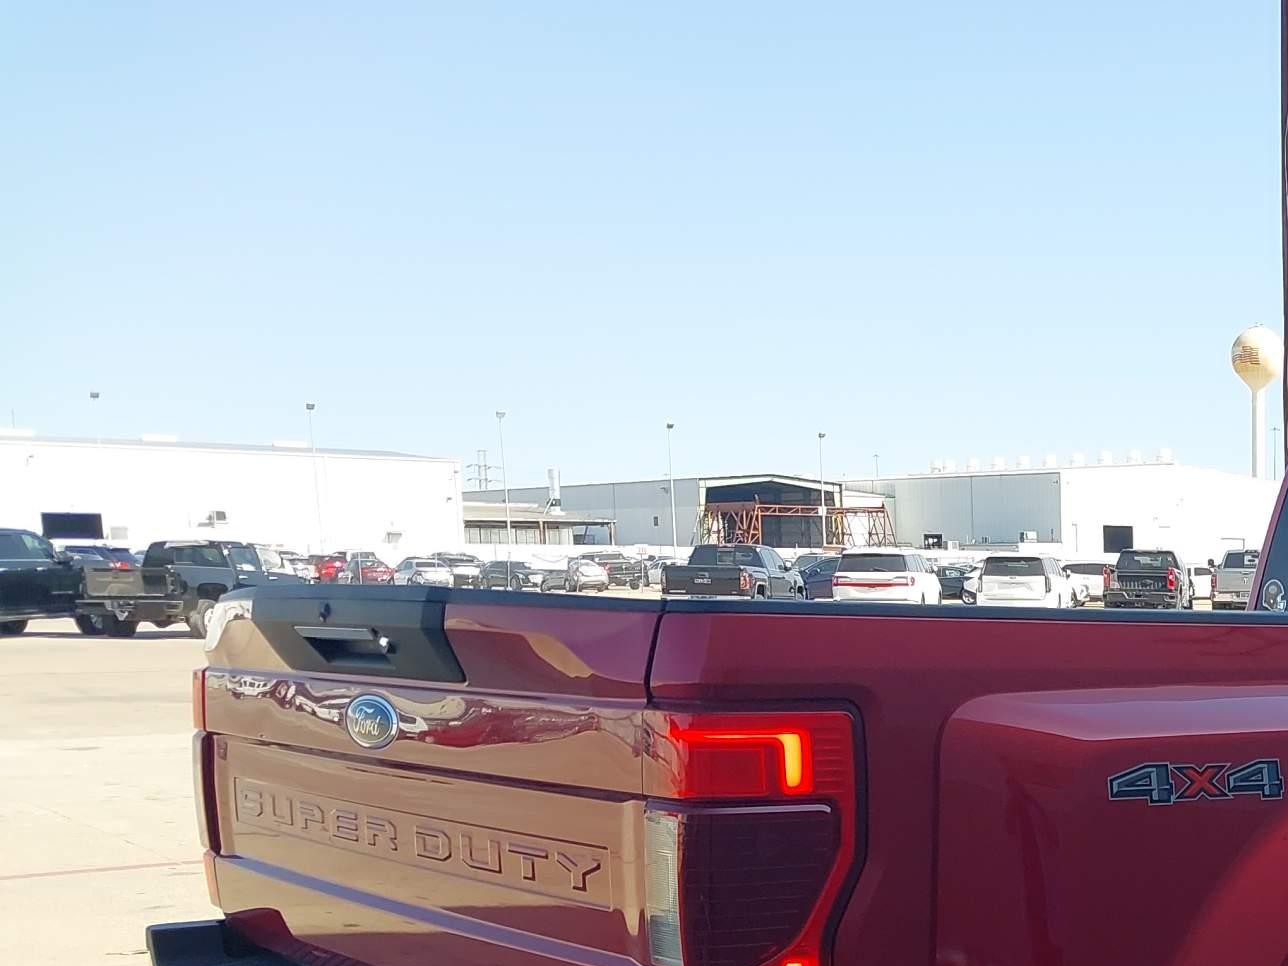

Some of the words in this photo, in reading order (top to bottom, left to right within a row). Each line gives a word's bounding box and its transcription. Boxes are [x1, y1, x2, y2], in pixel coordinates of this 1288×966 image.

[353, 705, 381, 736] Ford
[239, 787, 399, 852] SUPER
[414, 825, 602, 892] DUTY
